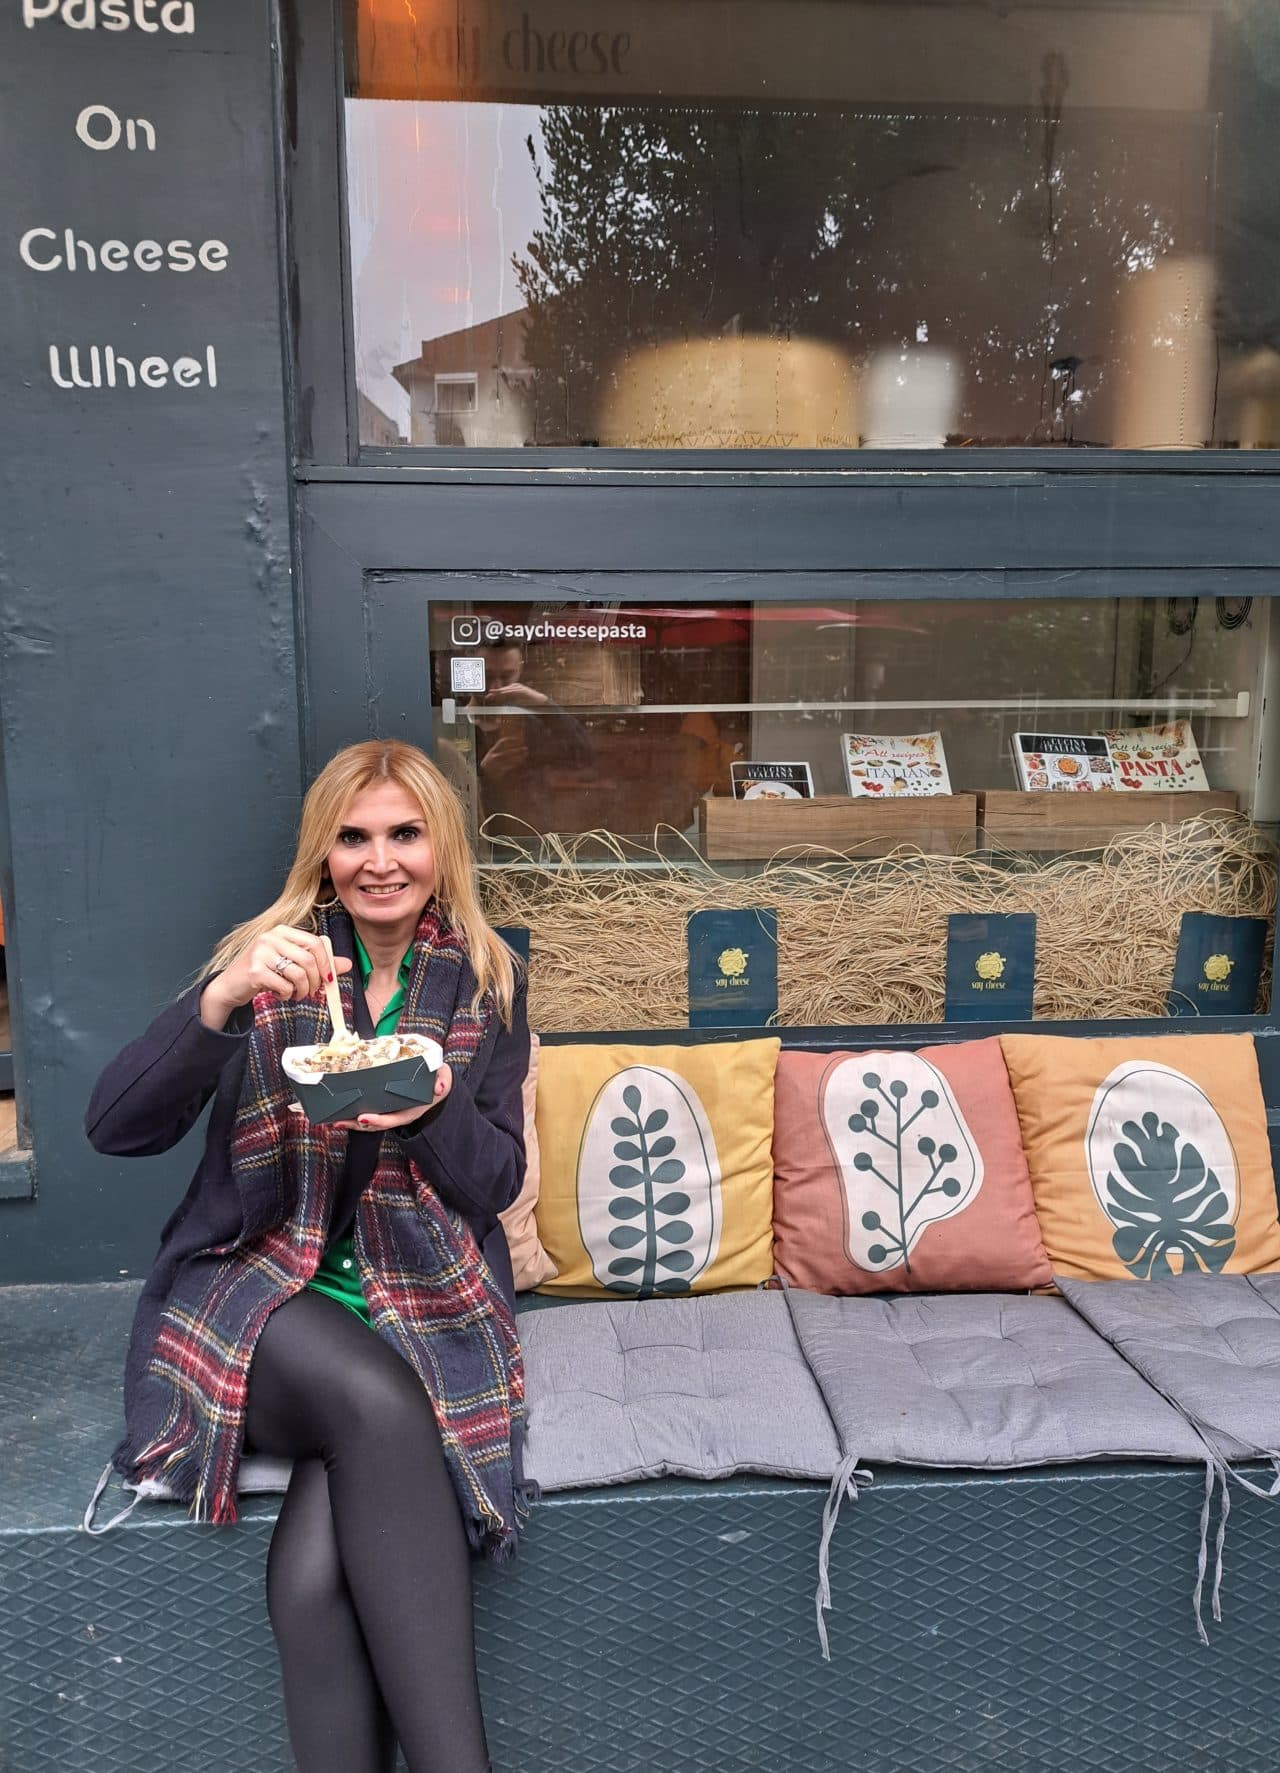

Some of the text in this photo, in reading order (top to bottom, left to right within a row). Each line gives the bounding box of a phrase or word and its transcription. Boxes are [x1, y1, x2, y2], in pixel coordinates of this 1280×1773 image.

[502, 12, 632, 76] cheese
[75, 104, 156, 151] On
[19, 227, 229, 272] Cheese
[49, 344, 217, 388] Wheel
[485, 621, 647, 641] @saycheesepasta
[866, 767, 931, 778] ITALIAN
[1120, 759, 1185, 776] PASTA
